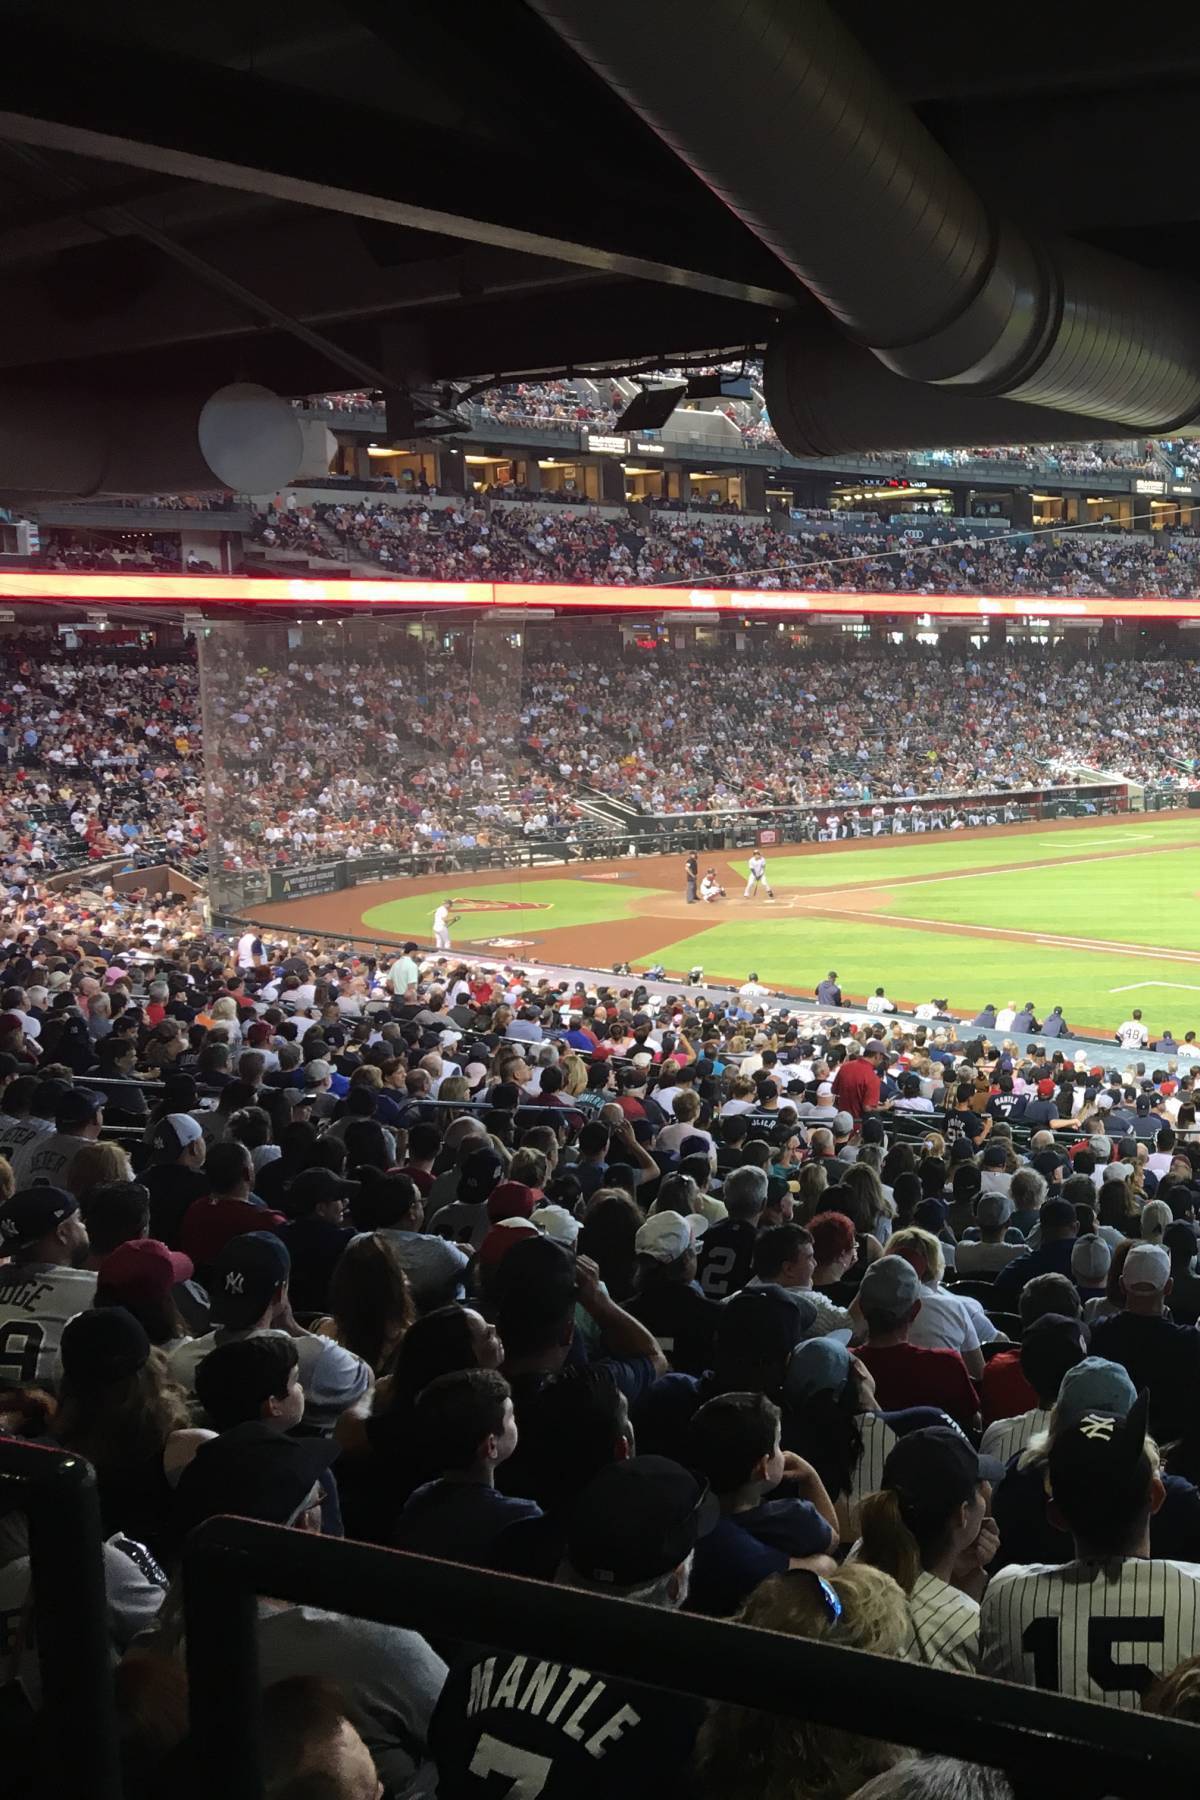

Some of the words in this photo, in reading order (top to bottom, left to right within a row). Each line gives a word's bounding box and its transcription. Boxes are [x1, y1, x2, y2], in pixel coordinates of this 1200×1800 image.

[1125, 1028, 1141, 1041] 48
[1000, 1105, 1012, 1117] 7
[701, 1246, 736, 1295] 2
[1022, 1616, 1165, 1701] 15
[465, 1655, 642, 1760] MANTLE
[468, 1732, 553, 1800] 7
